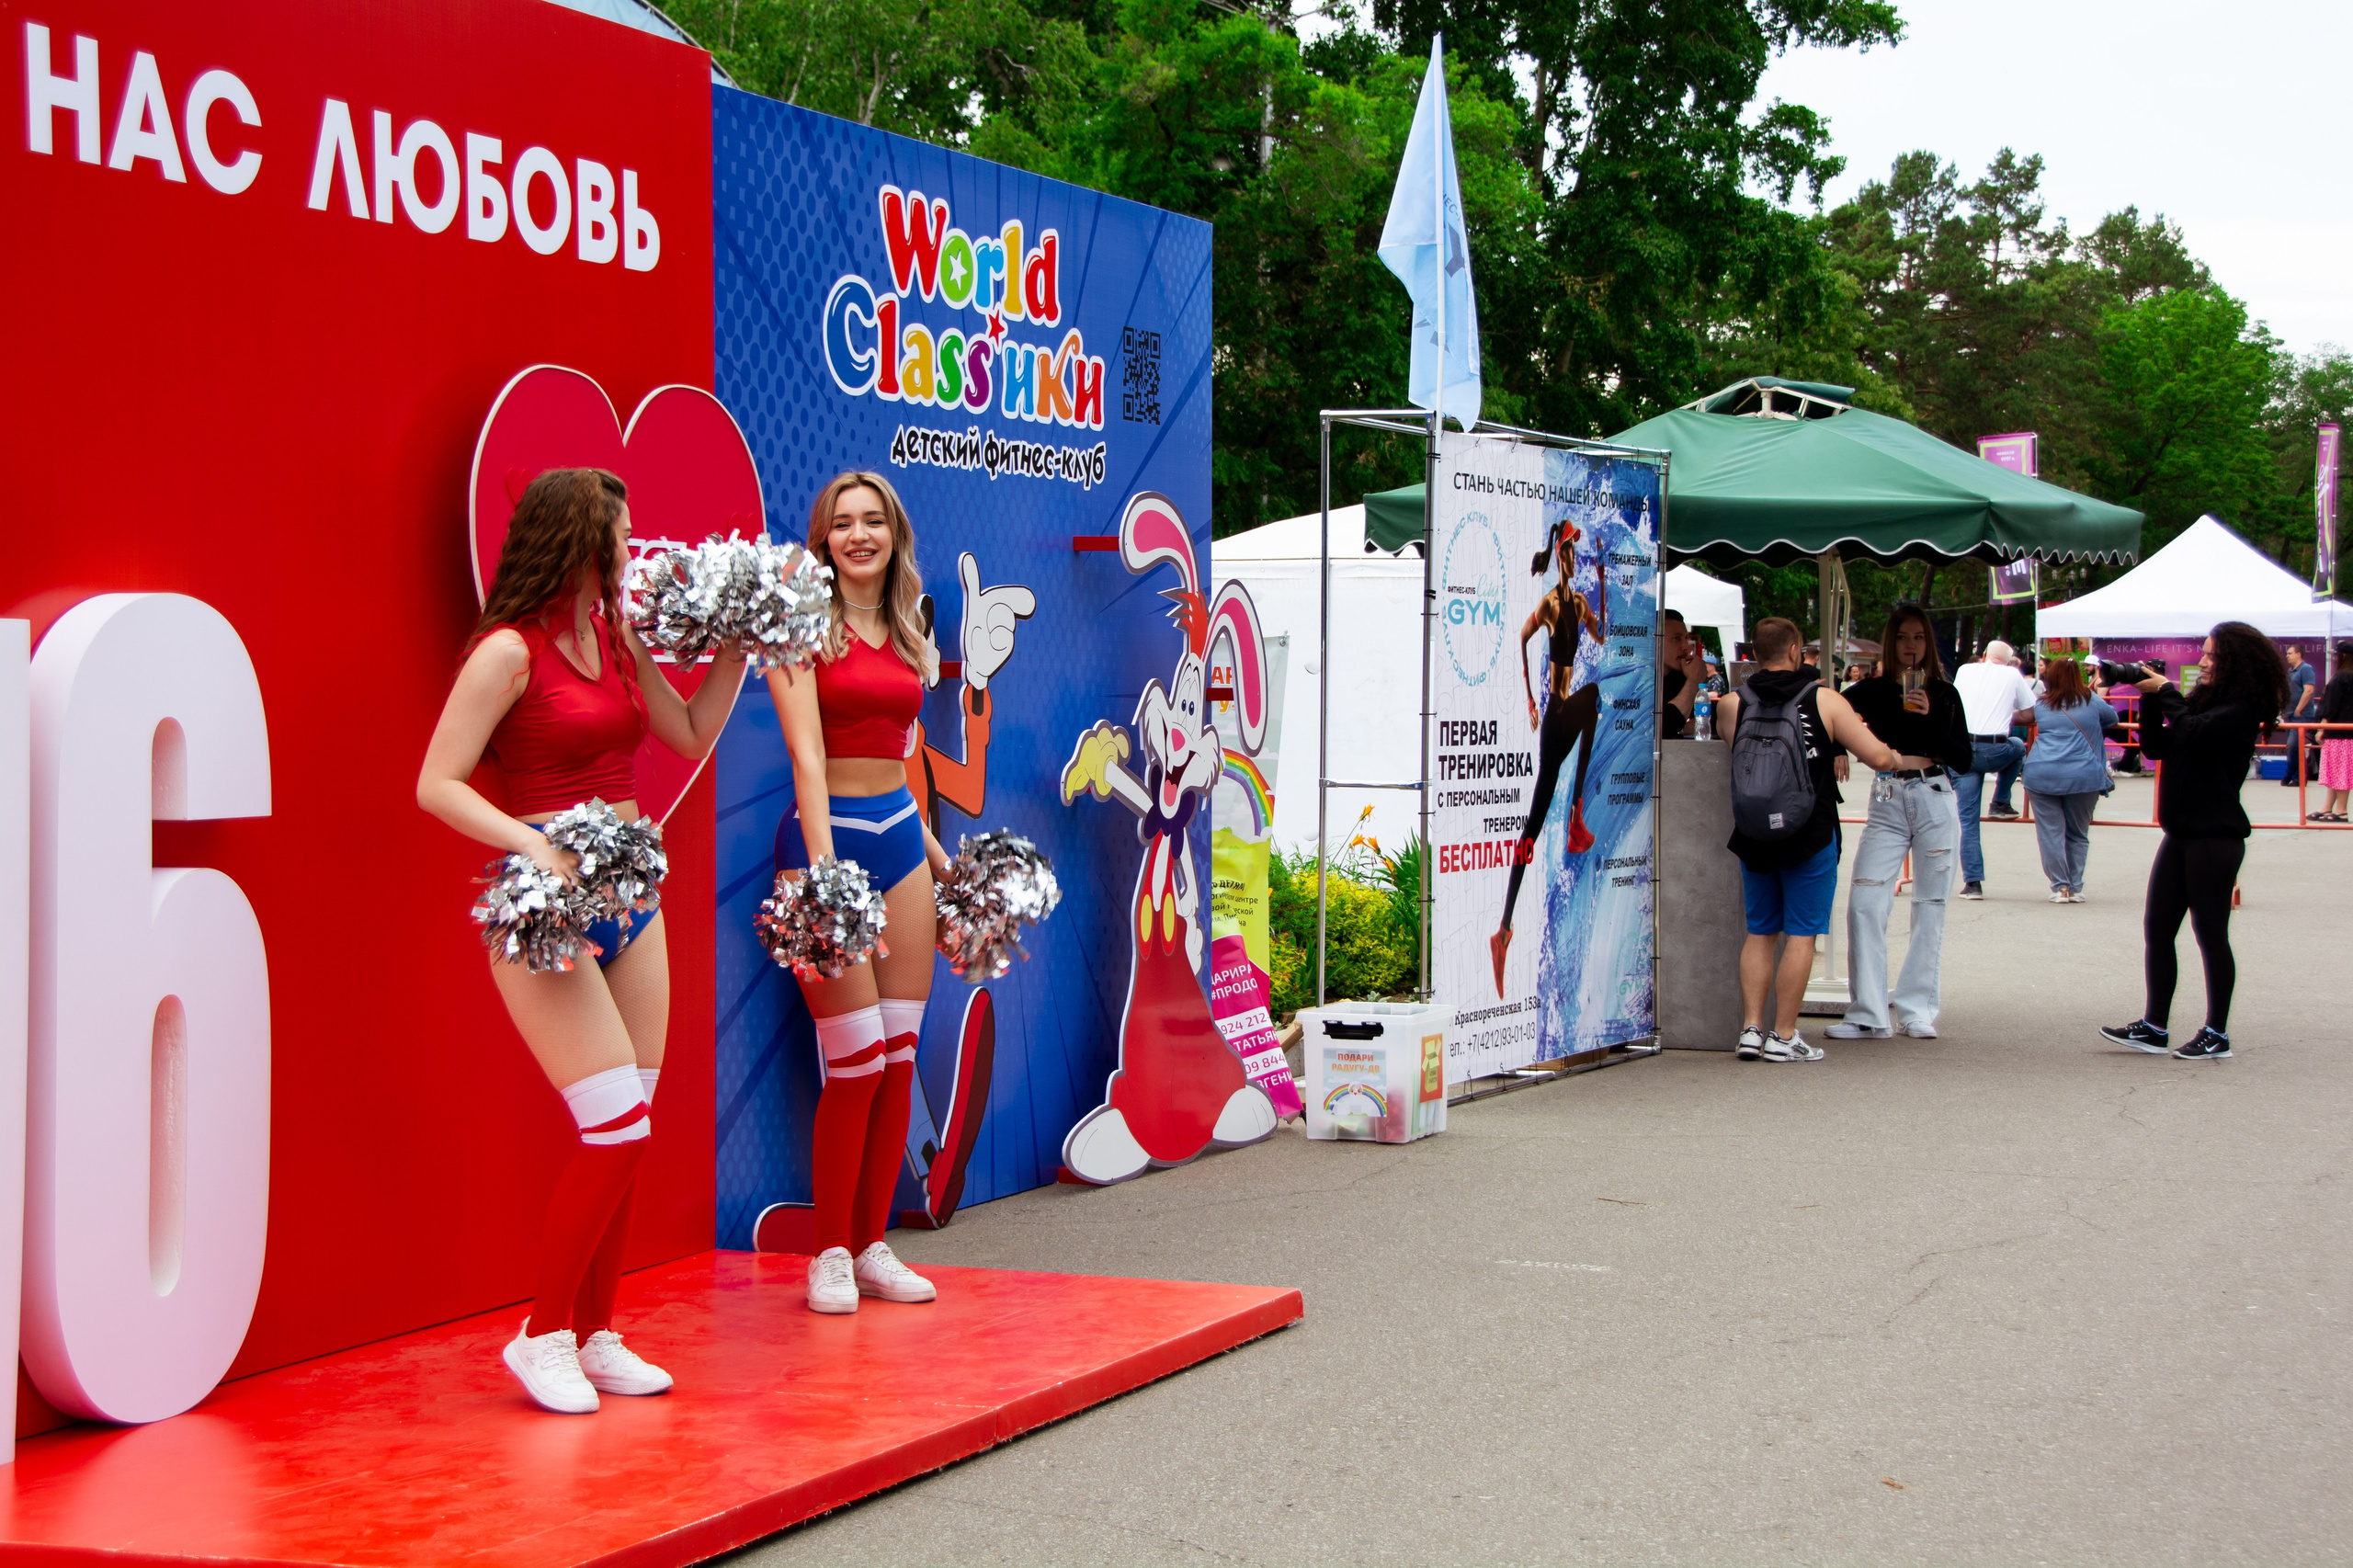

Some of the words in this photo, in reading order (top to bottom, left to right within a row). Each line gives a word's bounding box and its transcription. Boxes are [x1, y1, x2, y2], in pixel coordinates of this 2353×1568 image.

[26, 22, 263, 195] НАС
[307, 97, 661, 272] ЛЮБОВЬ
[880, 185, 1059, 327] World
[892, 426, 982, 469] детский
[983, 430, 1105, 489] фитнес-клуб
[1453, 472, 1495, 494] СТАНЬ
[1497, 477, 1546, 500] ЧАСТЬЮ
[1549, 484, 1590, 506] НАШЕЙ
[1593, 491, 1650, 513] КОМАНДЫ
[1466, 511, 1489, 528] КЛУБ
[1608, 553, 1652, 567] ТРЕНАЖЕРНЫЙ
[1621, 574, 1633, 586] ЗАЛ
[1447, 598, 1500, 626] GYM
[1609, 623, 1648, 639] БОЙЦОВСКАЯ
[1618, 645, 1634, 657] ЗОНА
[1613, 699, 1641, 710] ФИНСКАЯ
[1439, 720, 1497, 746] ПЕРВАЯ
[1615, 719, 1634, 731] САУНА
[1438, 752, 1533, 780] ТРЕНИРОВКА
[1611, 772, 1645, 785] ГРУППОВЫЕ
[1438, 791, 1444, 808] С
[1446, 788, 1520, 807] ПЕРСОНАЛЬНЫМ
[1608, 792, 1644, 806] ПРОГРАММЫ
[1439, 836, 1534, 873] БЕСПЛАТНО
[1603, 855, 1647, 870] ПЕРСОНАЛЬНЫЙ
[1611, 875, 1635, 888] ТРЕНИНГ
[1454, 1002, 1521, 1028] Краснореченская
[1524, 995, 1541, 1012] 153а
[1221, 1021, 1243, 1035] 924
[1449, 1040, 1465, 1057] ел.:
[1467, 1022, 1536, 1056] +7(4212)93-01-03
[1337, 1052, 1374, 1062] ПОДАРИ
[1331, 1062, 1381, 1074] РАДУГУ-ДВ
